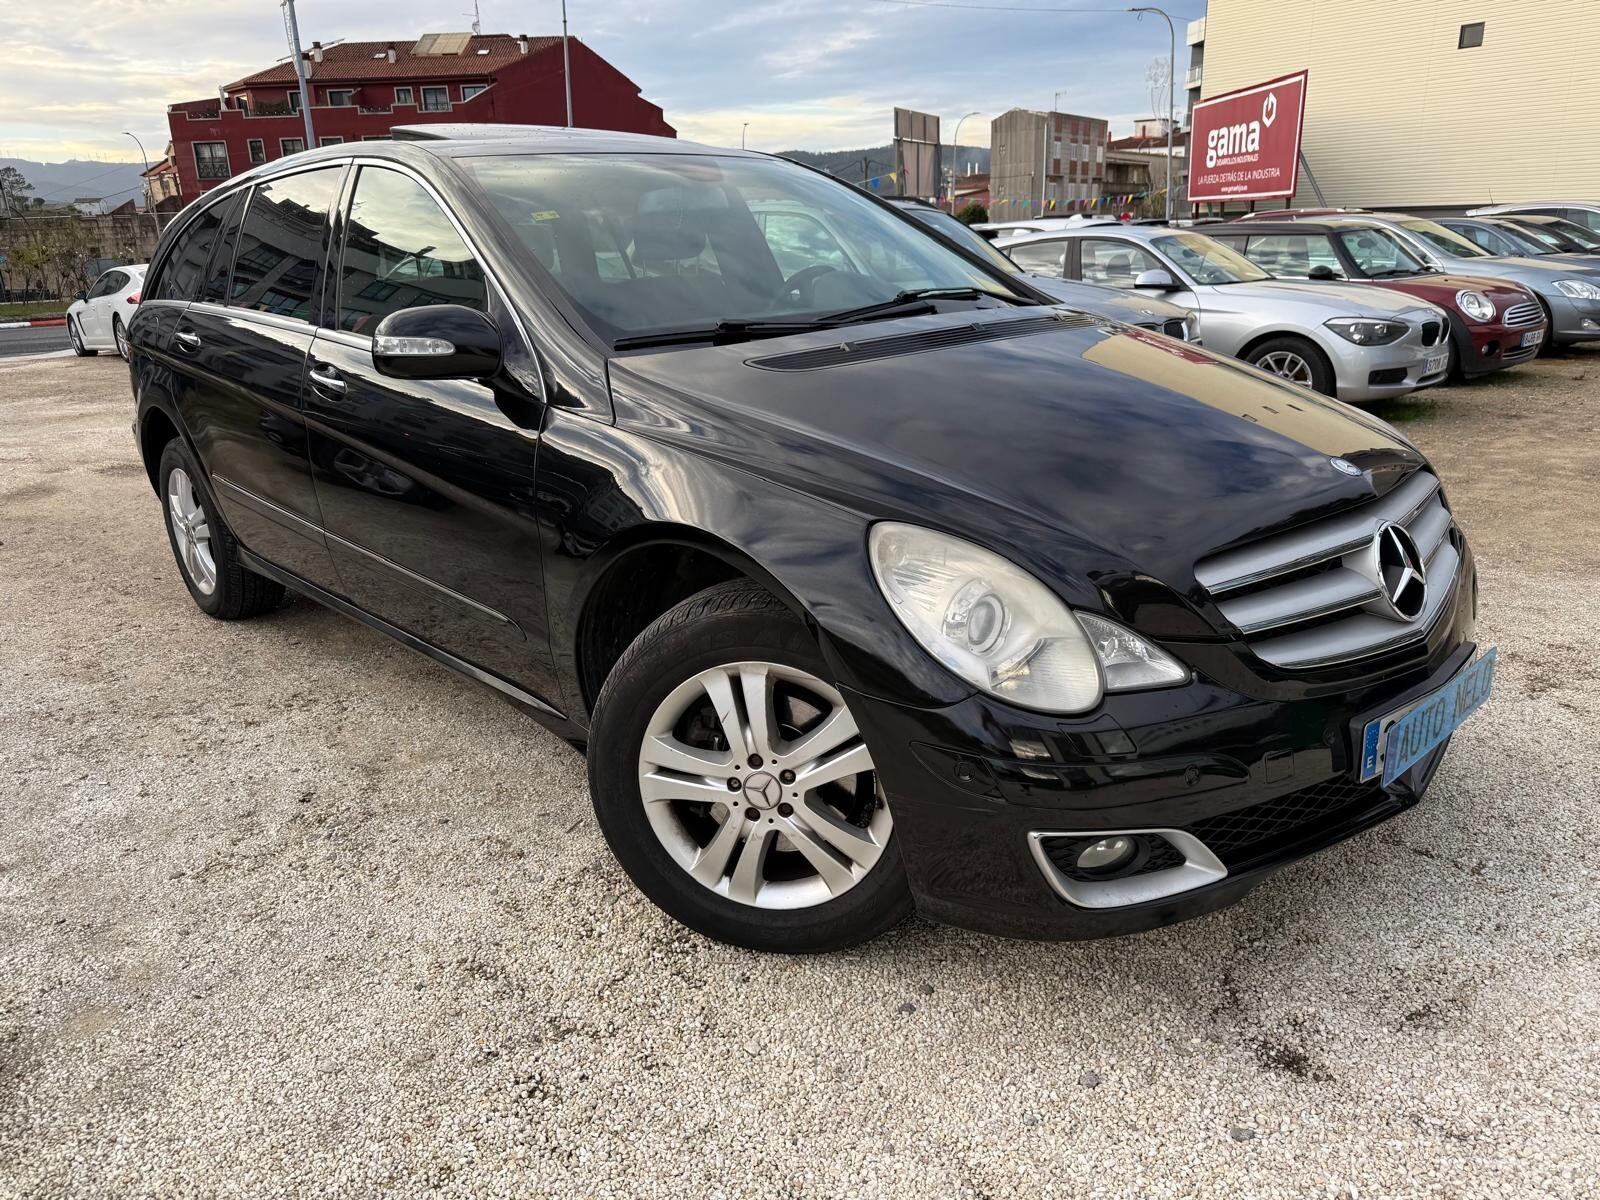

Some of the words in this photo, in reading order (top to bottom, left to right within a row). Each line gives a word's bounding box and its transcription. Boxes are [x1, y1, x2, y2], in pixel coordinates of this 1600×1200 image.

[1206, 120, 1260, 168] gama
[1198, 176, 1203, 184] LA
[1204, 174, 1219, 184] FUERZA
[1219, 170, 1236, 183] DETRÁS
[1237, 172, 1244, 181] DE
[1245, 171, 1251, 180] LA
[1252, 168, 1280, 179] INDUSTRIA
[1397, 696, 1446, 768] AUTO
[1452, 658, 1493, 724] NELO
[1366, 755, 1374, 769] E
